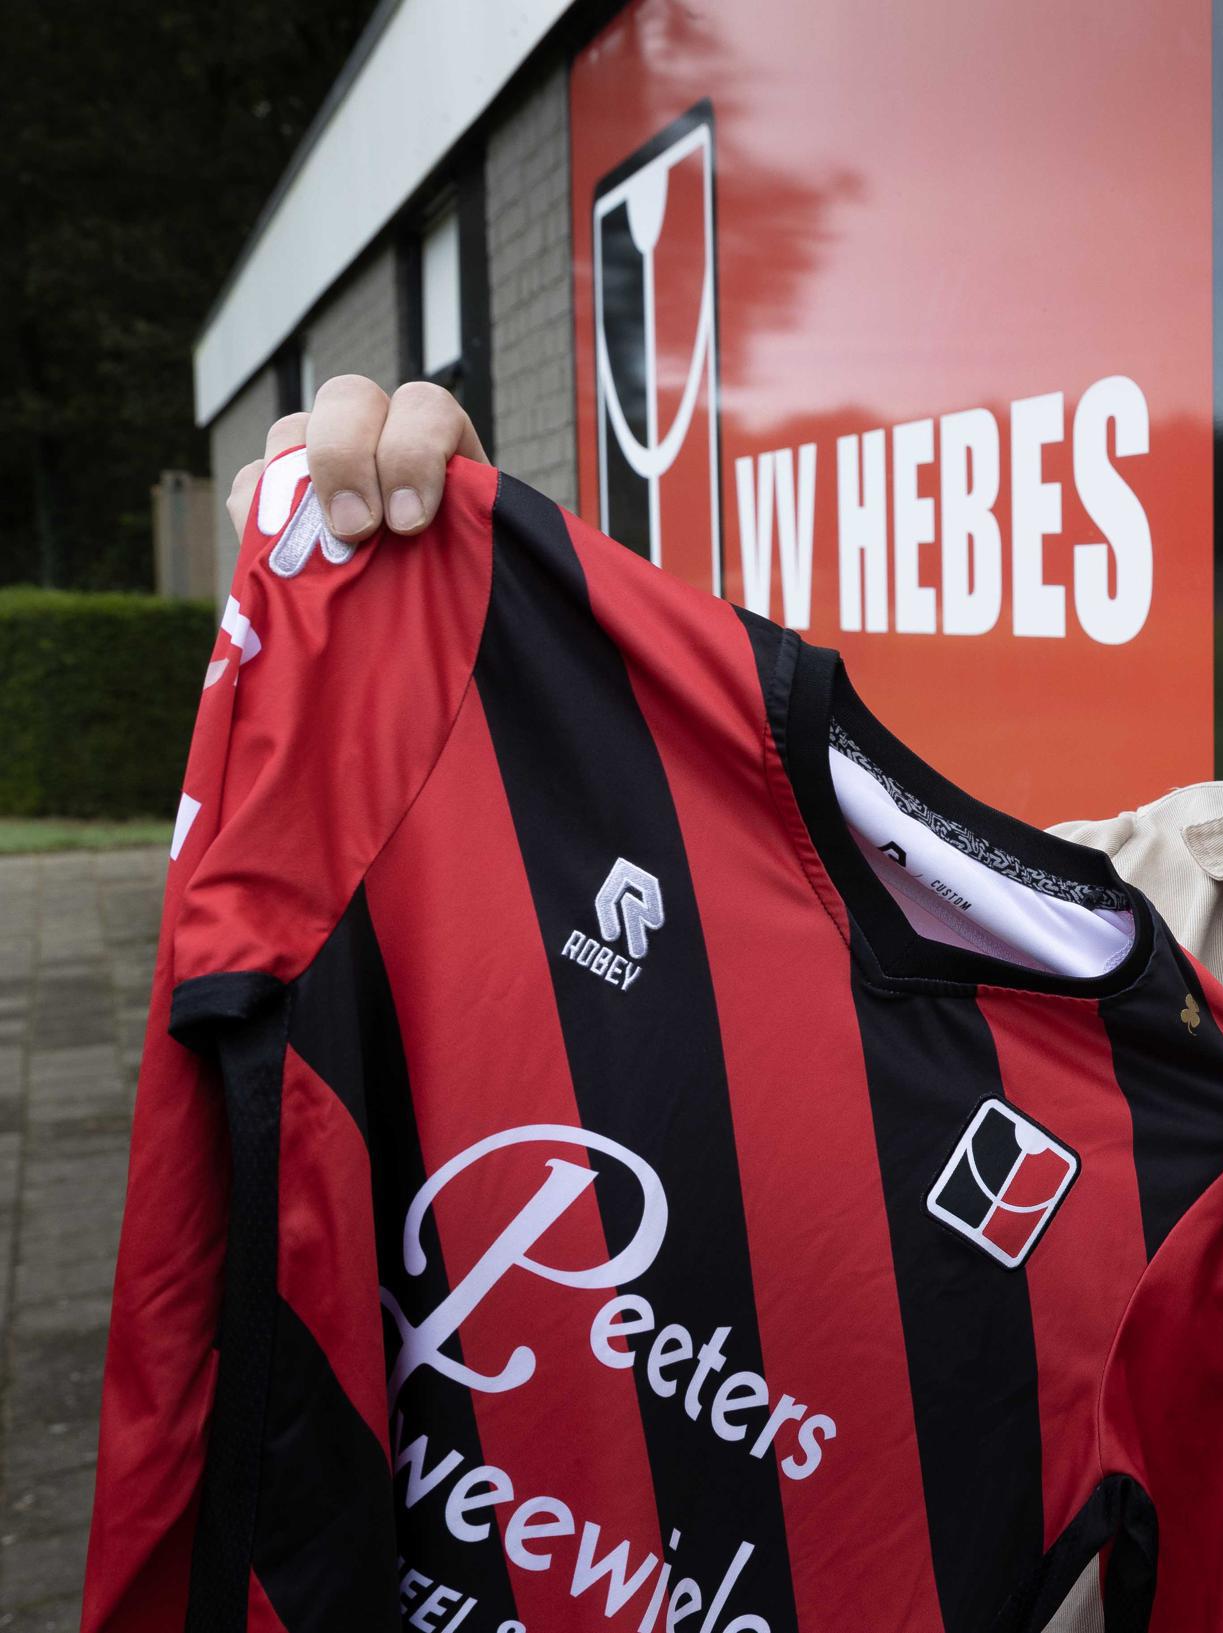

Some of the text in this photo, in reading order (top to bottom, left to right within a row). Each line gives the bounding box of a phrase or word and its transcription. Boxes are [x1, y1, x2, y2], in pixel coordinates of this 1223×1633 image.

[837, 375, 1154, 646] HEBES
[561, 929, 643, 992] ROBEY
[930, 879, 973, 912] CUSTOM
[380, 1123, 838, 1481] Peeters
[394, 1409, 771, 1633] weewiel
